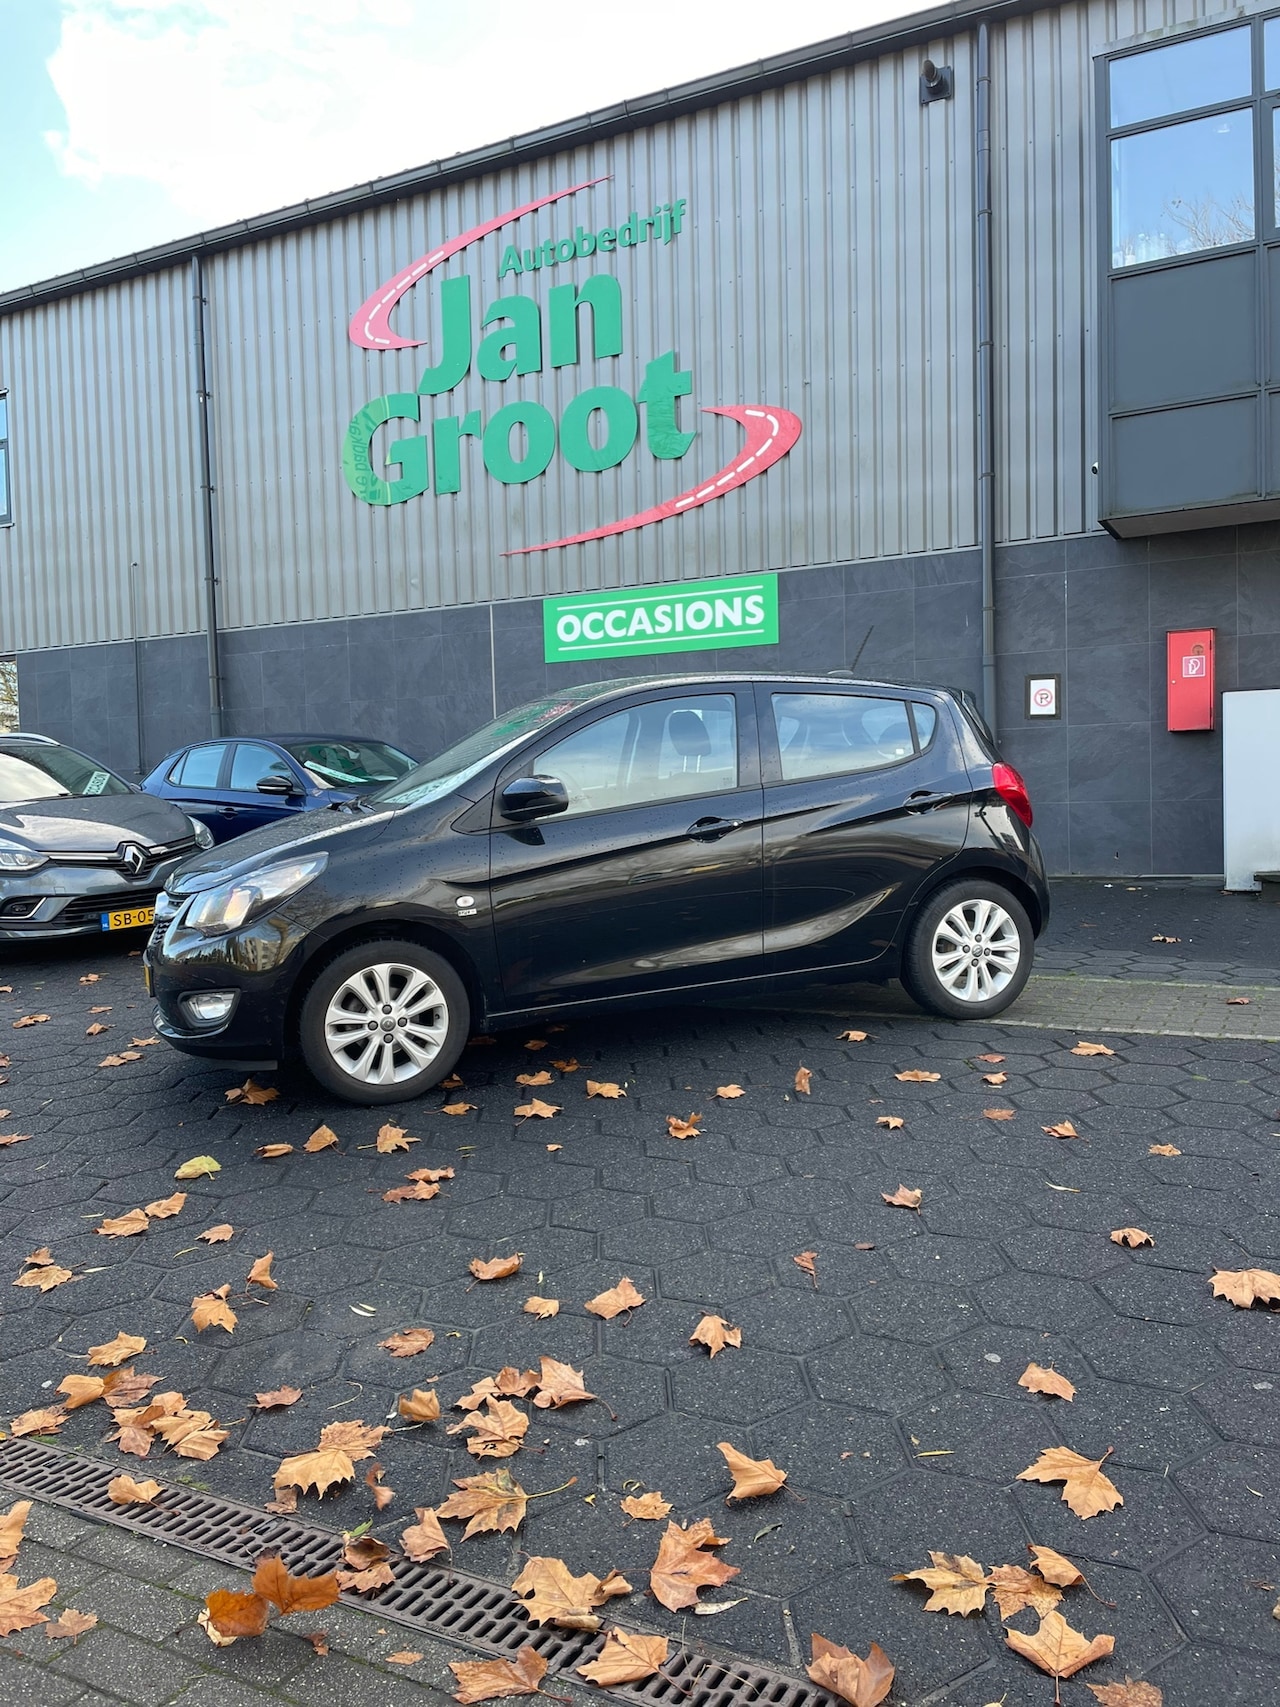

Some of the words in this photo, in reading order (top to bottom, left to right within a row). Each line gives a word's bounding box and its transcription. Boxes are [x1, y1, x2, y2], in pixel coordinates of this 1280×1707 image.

[498, 199, 687, 279] Autobedrijf
[417, 273, 624, 396] Jan
[342, 350, 698, 507] Groot
[556, 595, 765, 643] OCCASIONS
[113, 909, 154, 927] SB-05
